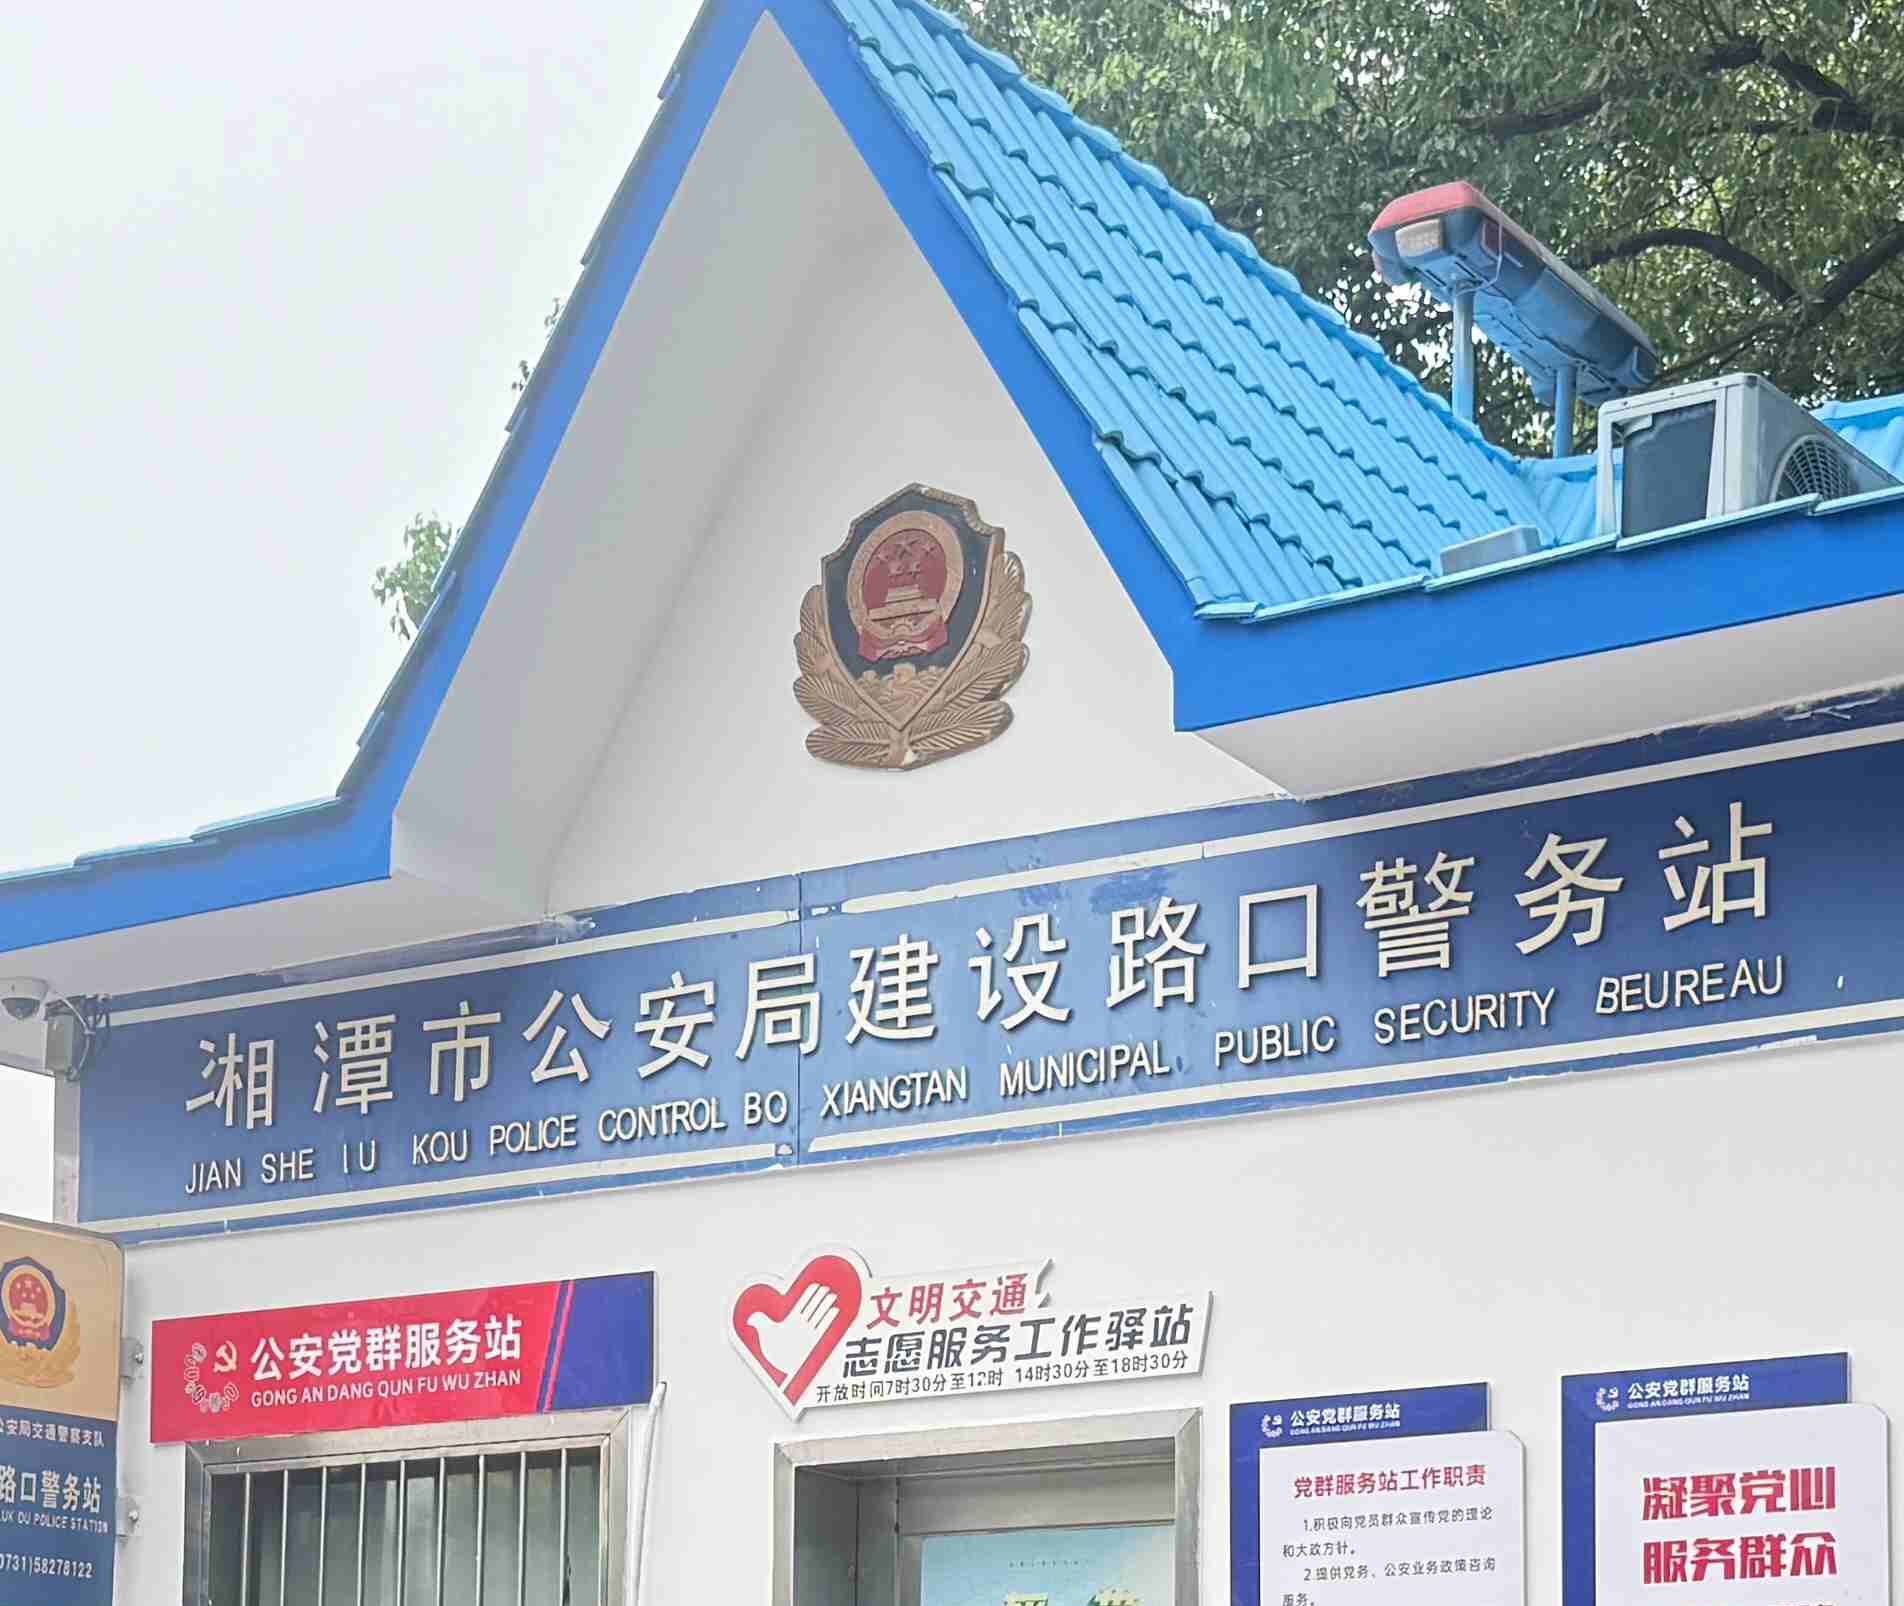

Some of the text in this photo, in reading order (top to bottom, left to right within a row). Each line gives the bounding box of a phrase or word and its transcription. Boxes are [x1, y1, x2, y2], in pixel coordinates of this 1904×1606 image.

[185, 801, 1775, 1129] 湘潭市公安局建设路口警务站
[185, 1157, 242, 1195] JIAN
[261, 1147, 315, 1184] SHE
[412, 1128, 469, 1166] KOU
[490, 1114, 578, 1157] POLICE
[597, 1097, 727, 1143] CONTROL
[744, 1091, 788, 1125] BO
[820, 1066, 968, 1117] XIANGTAN
[1000, 1040, 1171, 1098] MUNICIPAL
[1214, 1016, 1337, 1067] PUBLIC
[1374, 988, 1557, 1045] SECURITY
[1595, 955, 1786, 1016] BEUREAU
[866, 1273, 1029, 1328] 文明交通
[250, 1313, 522, 1381] 公安党群服务站
[842, 1304, 1194, 1378] 志愿服务工作驿站
[1015, 1352, 1189, 1383] 14时30分至18时30分
[251, 1369, 521, 1408] GONG AN DANG QUN FU WU ZHAN
[1626, 1374, 1750, 1400] 公安党群服务站
[1290, 1403, 1401, 1427] 公安党群服务站
[1294, 1464, 1487, 1499] 党群服务站工作职责
[1642, 1466, 1836, 1521] 凝聚党心
[33, 1513, 68, 1529] POLICE
[1643, 1531, 1837, 1585] 服务群众
